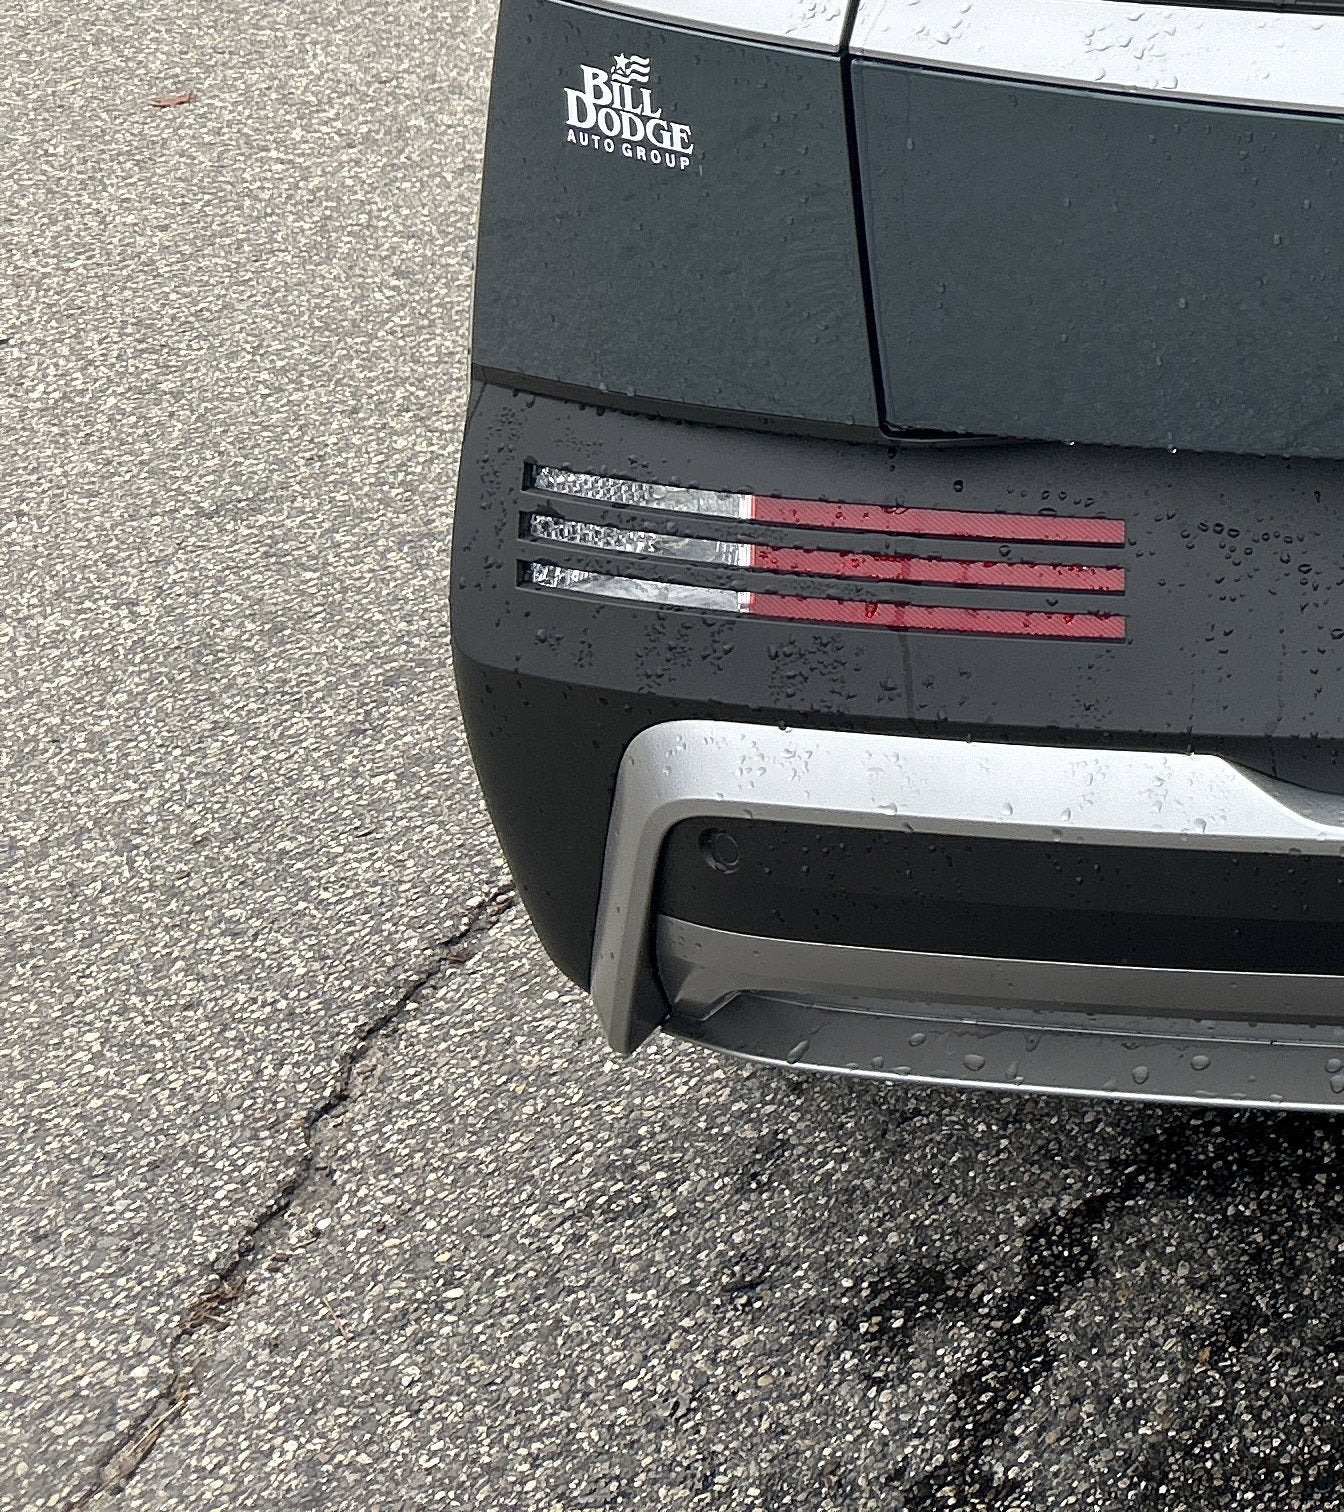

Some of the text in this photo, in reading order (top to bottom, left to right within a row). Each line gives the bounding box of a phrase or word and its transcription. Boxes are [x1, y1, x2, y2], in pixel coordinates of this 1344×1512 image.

[581, 64, 662, 118] BILL
[564, 87, 695, 155] DODGE
[567, 128, 691, 171] AUTO GROUP
